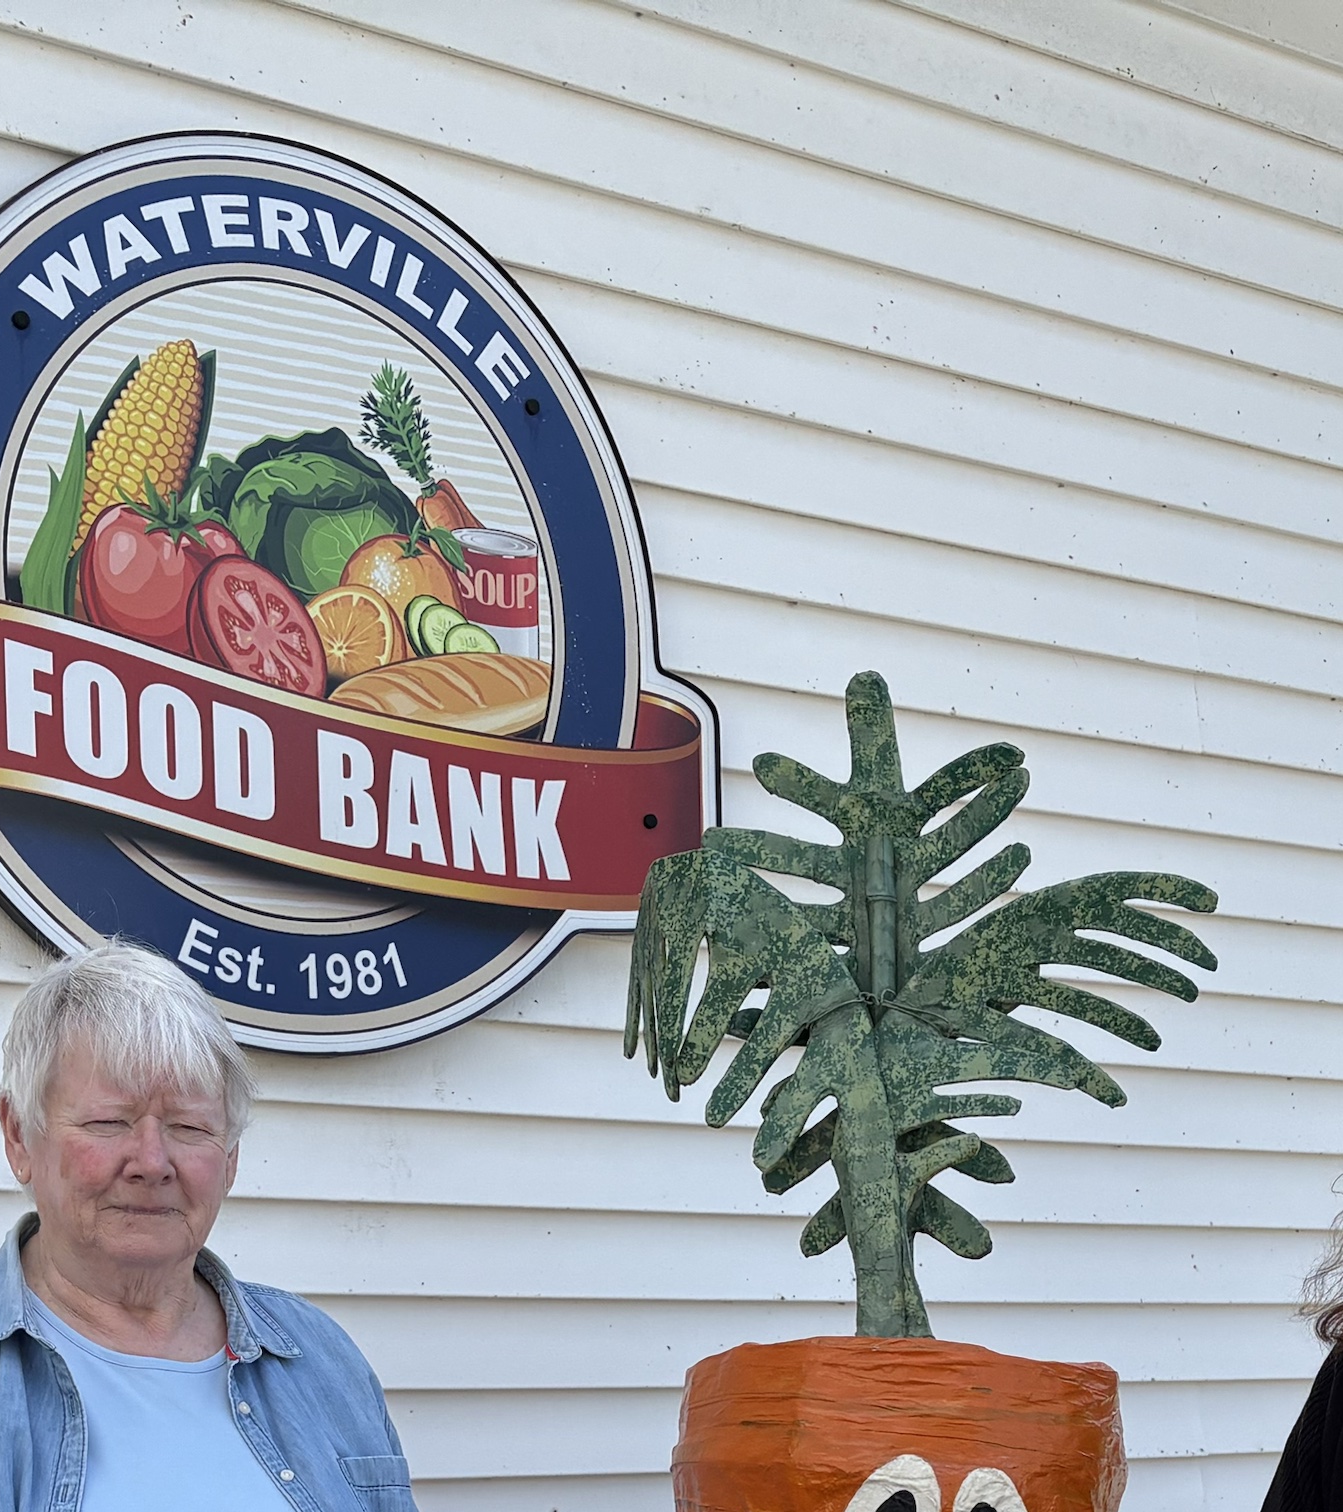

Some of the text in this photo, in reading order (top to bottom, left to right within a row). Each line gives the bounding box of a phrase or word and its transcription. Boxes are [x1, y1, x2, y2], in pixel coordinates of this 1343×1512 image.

[18, 194, 531, 402] WATERVILLE
[457, 562, 537, 609] SOUP
[3, 637, 571, 881] FOOD BANK
[178, 918, 407, 999] Est. 1981
